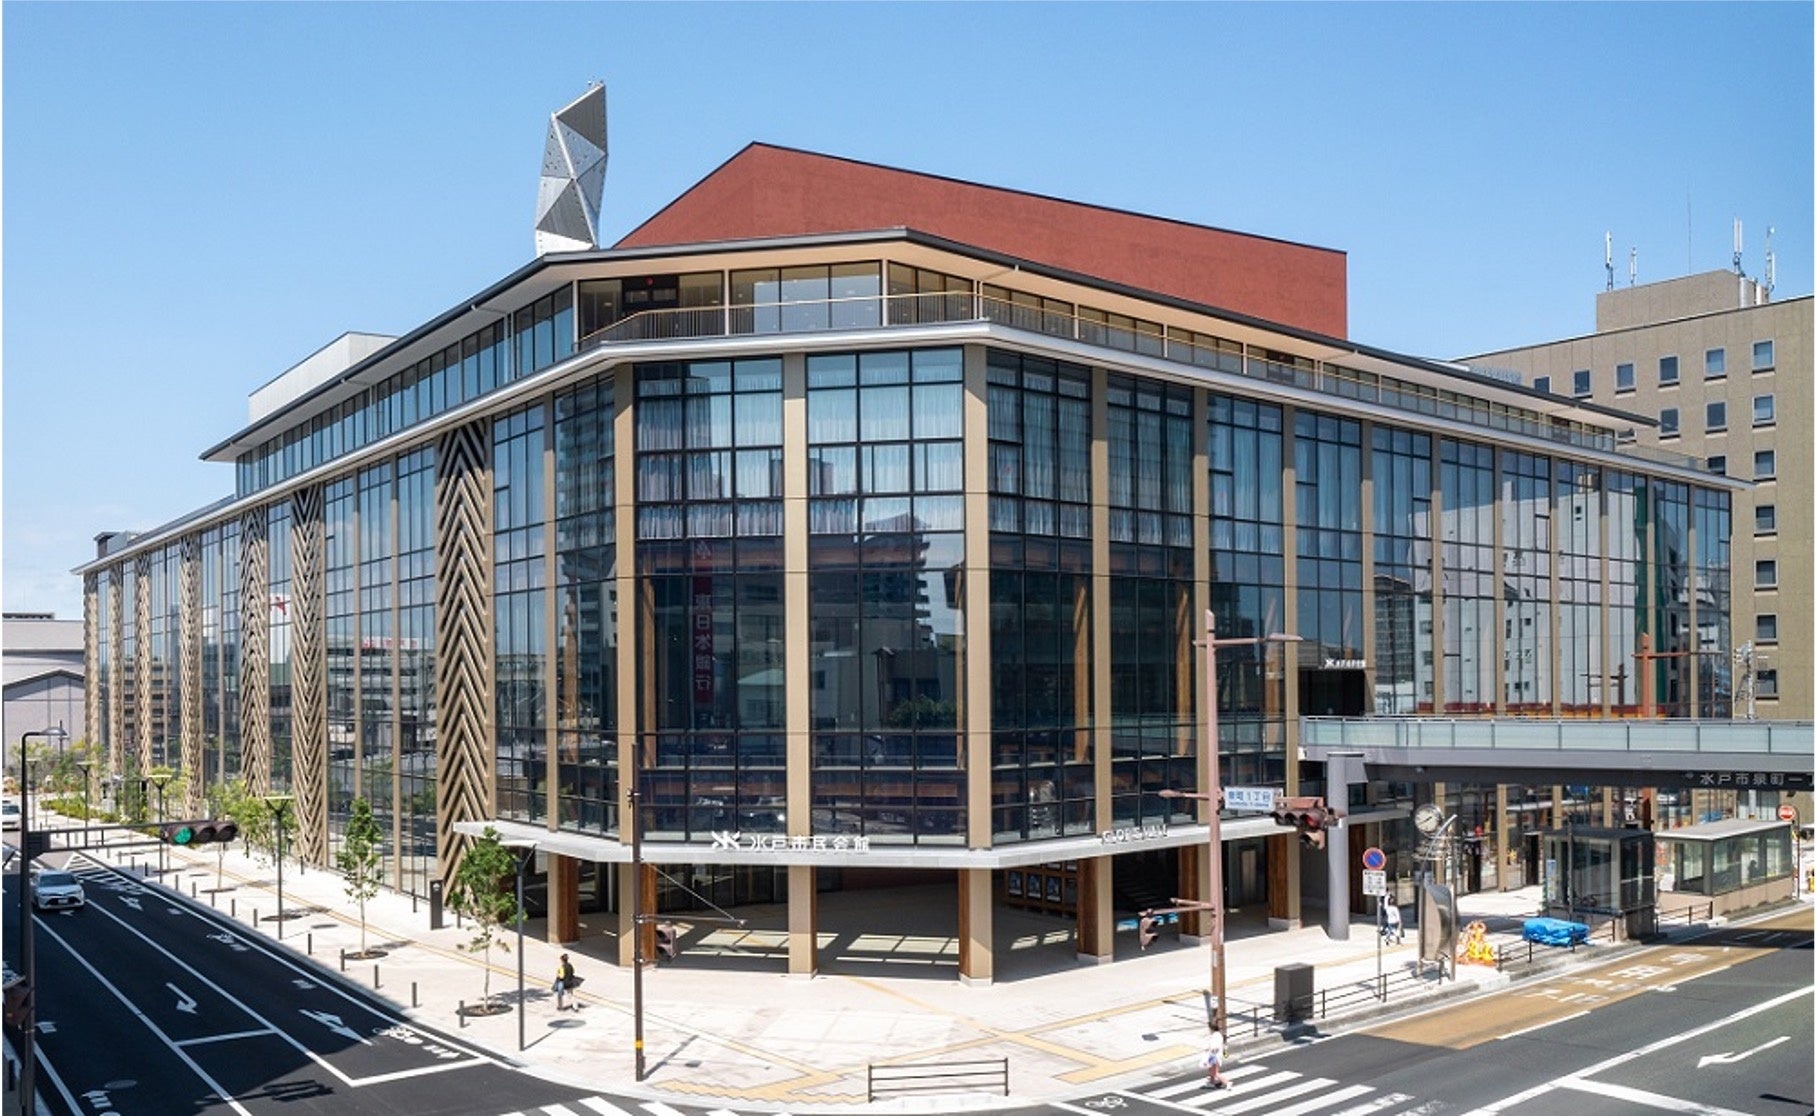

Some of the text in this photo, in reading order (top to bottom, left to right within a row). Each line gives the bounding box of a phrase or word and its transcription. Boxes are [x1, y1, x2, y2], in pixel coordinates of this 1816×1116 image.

[750, 834, 870, 852] 水戸市民会館
